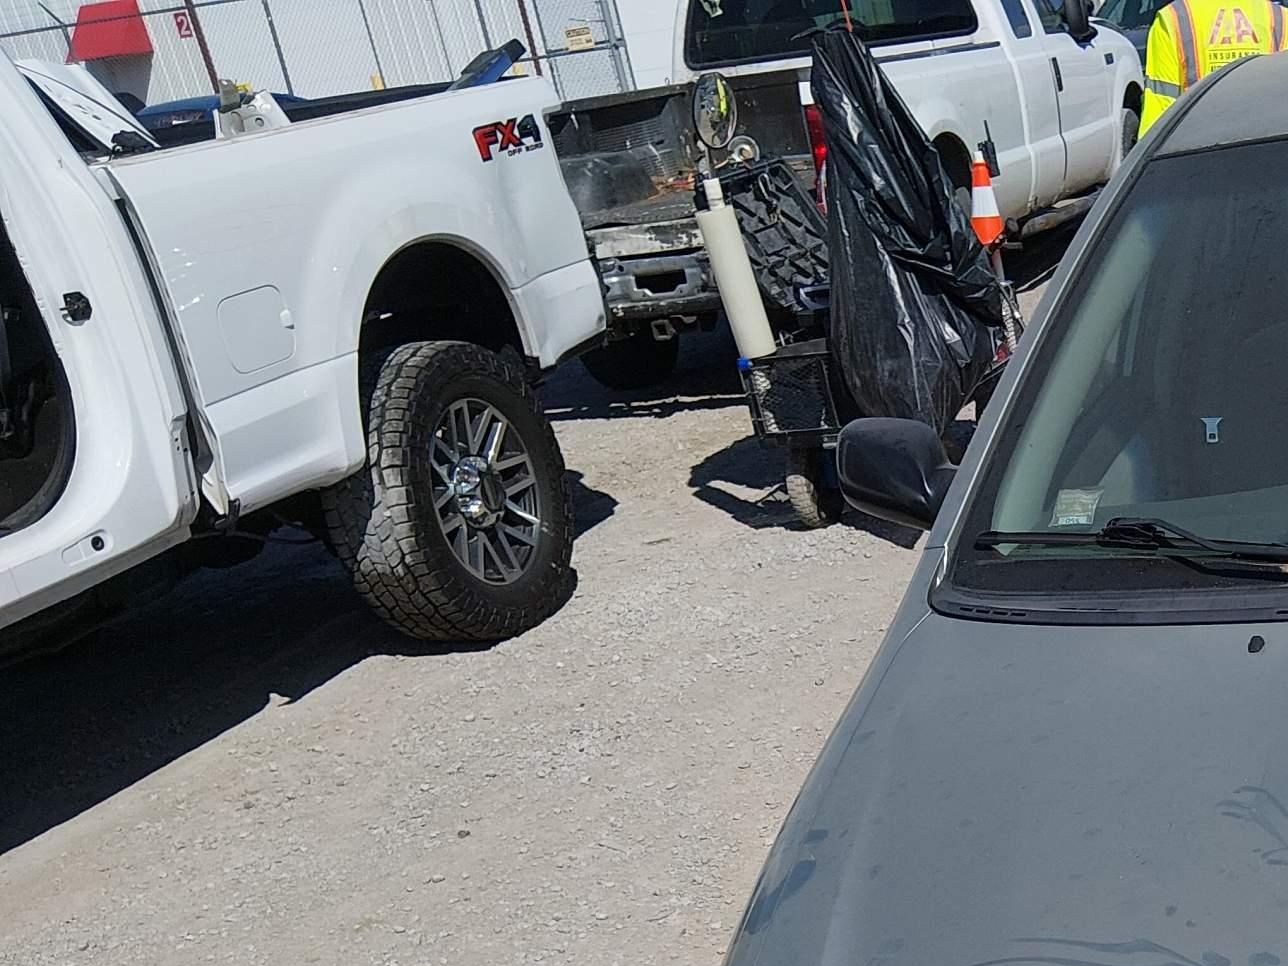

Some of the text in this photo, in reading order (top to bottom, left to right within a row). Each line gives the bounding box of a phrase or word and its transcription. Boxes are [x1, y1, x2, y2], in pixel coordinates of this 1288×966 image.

[176, 15, 192, 36] 2
[472, 113, 542, 162] FX4
[507, 147, 523, 157] OFF
